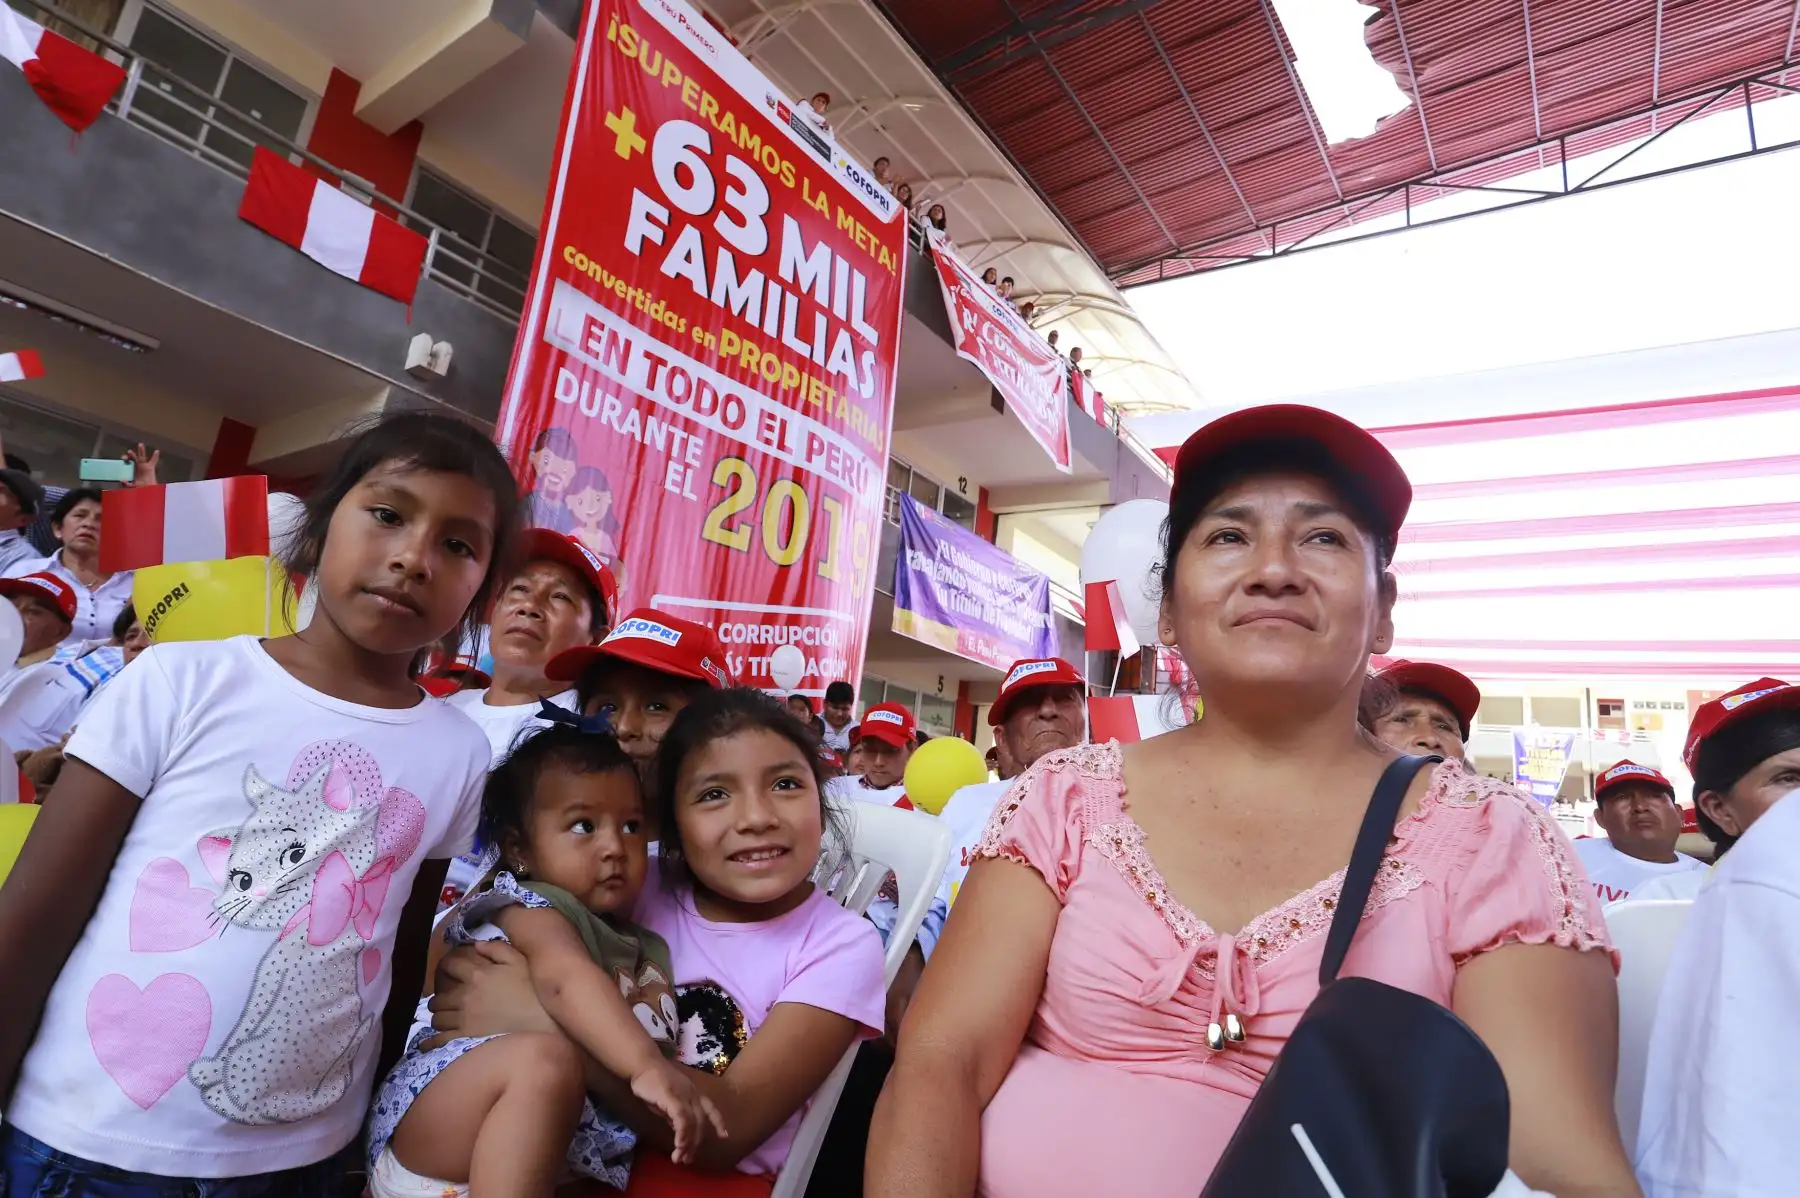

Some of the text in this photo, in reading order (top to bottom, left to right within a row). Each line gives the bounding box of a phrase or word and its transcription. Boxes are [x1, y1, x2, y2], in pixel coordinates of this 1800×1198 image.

[607, 12, 796, 188] ¡SUPERAMOS
[803, 177, 831, 220] LA
[836, 206, 897, 277] META!
[846, 164, 890, 211] COFOPRI
[624, 188, 876, 399] FAMILIAS
[652, 119, 769, 255] 63
[779, 213, 880, 347] MIL
[563, 245, 687, 333] convertidas
[691, 327, 716, 350] en
[718, 327, 885, 454] PROPIETARIAS
[579, 313, 871, 496] EN TODO EL PERÚ
[554, 367, 704, 468] DURANTE
[664, 460, 698, 502] EL
[701, 456, 870, 600] 2019
[958, 476, 968, 494] 12
[145, 582, 190, 634] COFOPRI
[937, 675, 944, 693] 5
